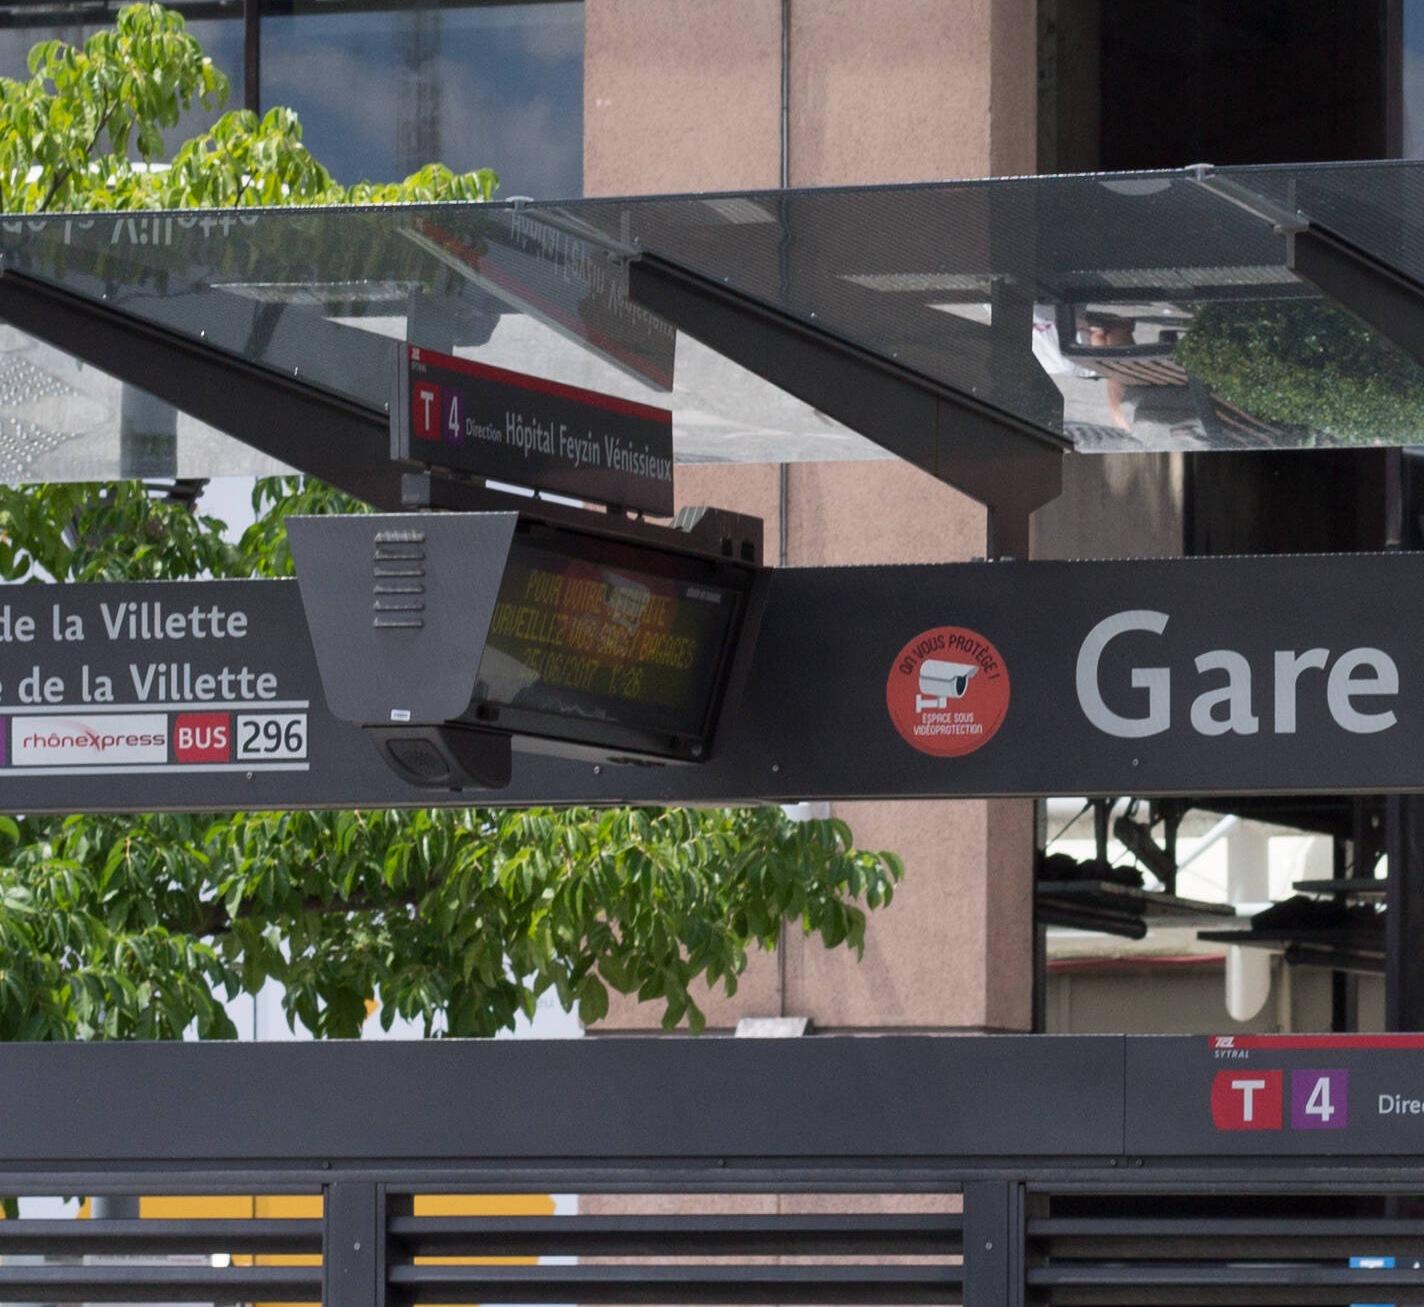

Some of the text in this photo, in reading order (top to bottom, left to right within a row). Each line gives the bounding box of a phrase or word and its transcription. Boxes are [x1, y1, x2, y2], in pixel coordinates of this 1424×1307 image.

[420, 389, 672, 482] T 4 Direction Hôpital Feyzin Vénissieux
[53, 604, 85, 641] la
[100, 602, 249, 640] Villette
[913, 634, 946, 659] VOUS
[948, 634, 998, 674] PROTÈGE
[18, 666, 66, 703] de
[82, 665, 115, 702] la
[129, 662, 278, 701] Villette
[1075, 609, 1400, 739] Gare
[178, 726, 227, 750] BUS
[242, 719, 303, 754] 296
[913, 721, 983, 736] VIDÉOPROTECTION
[922, 711, 974, 724] ESPACE SOUS
[1214, 1049, 1249, 1059] SYTRAL
[1231, 1079, 1266, 1122] T
[1305, 1076, 1336, 1122] 4
